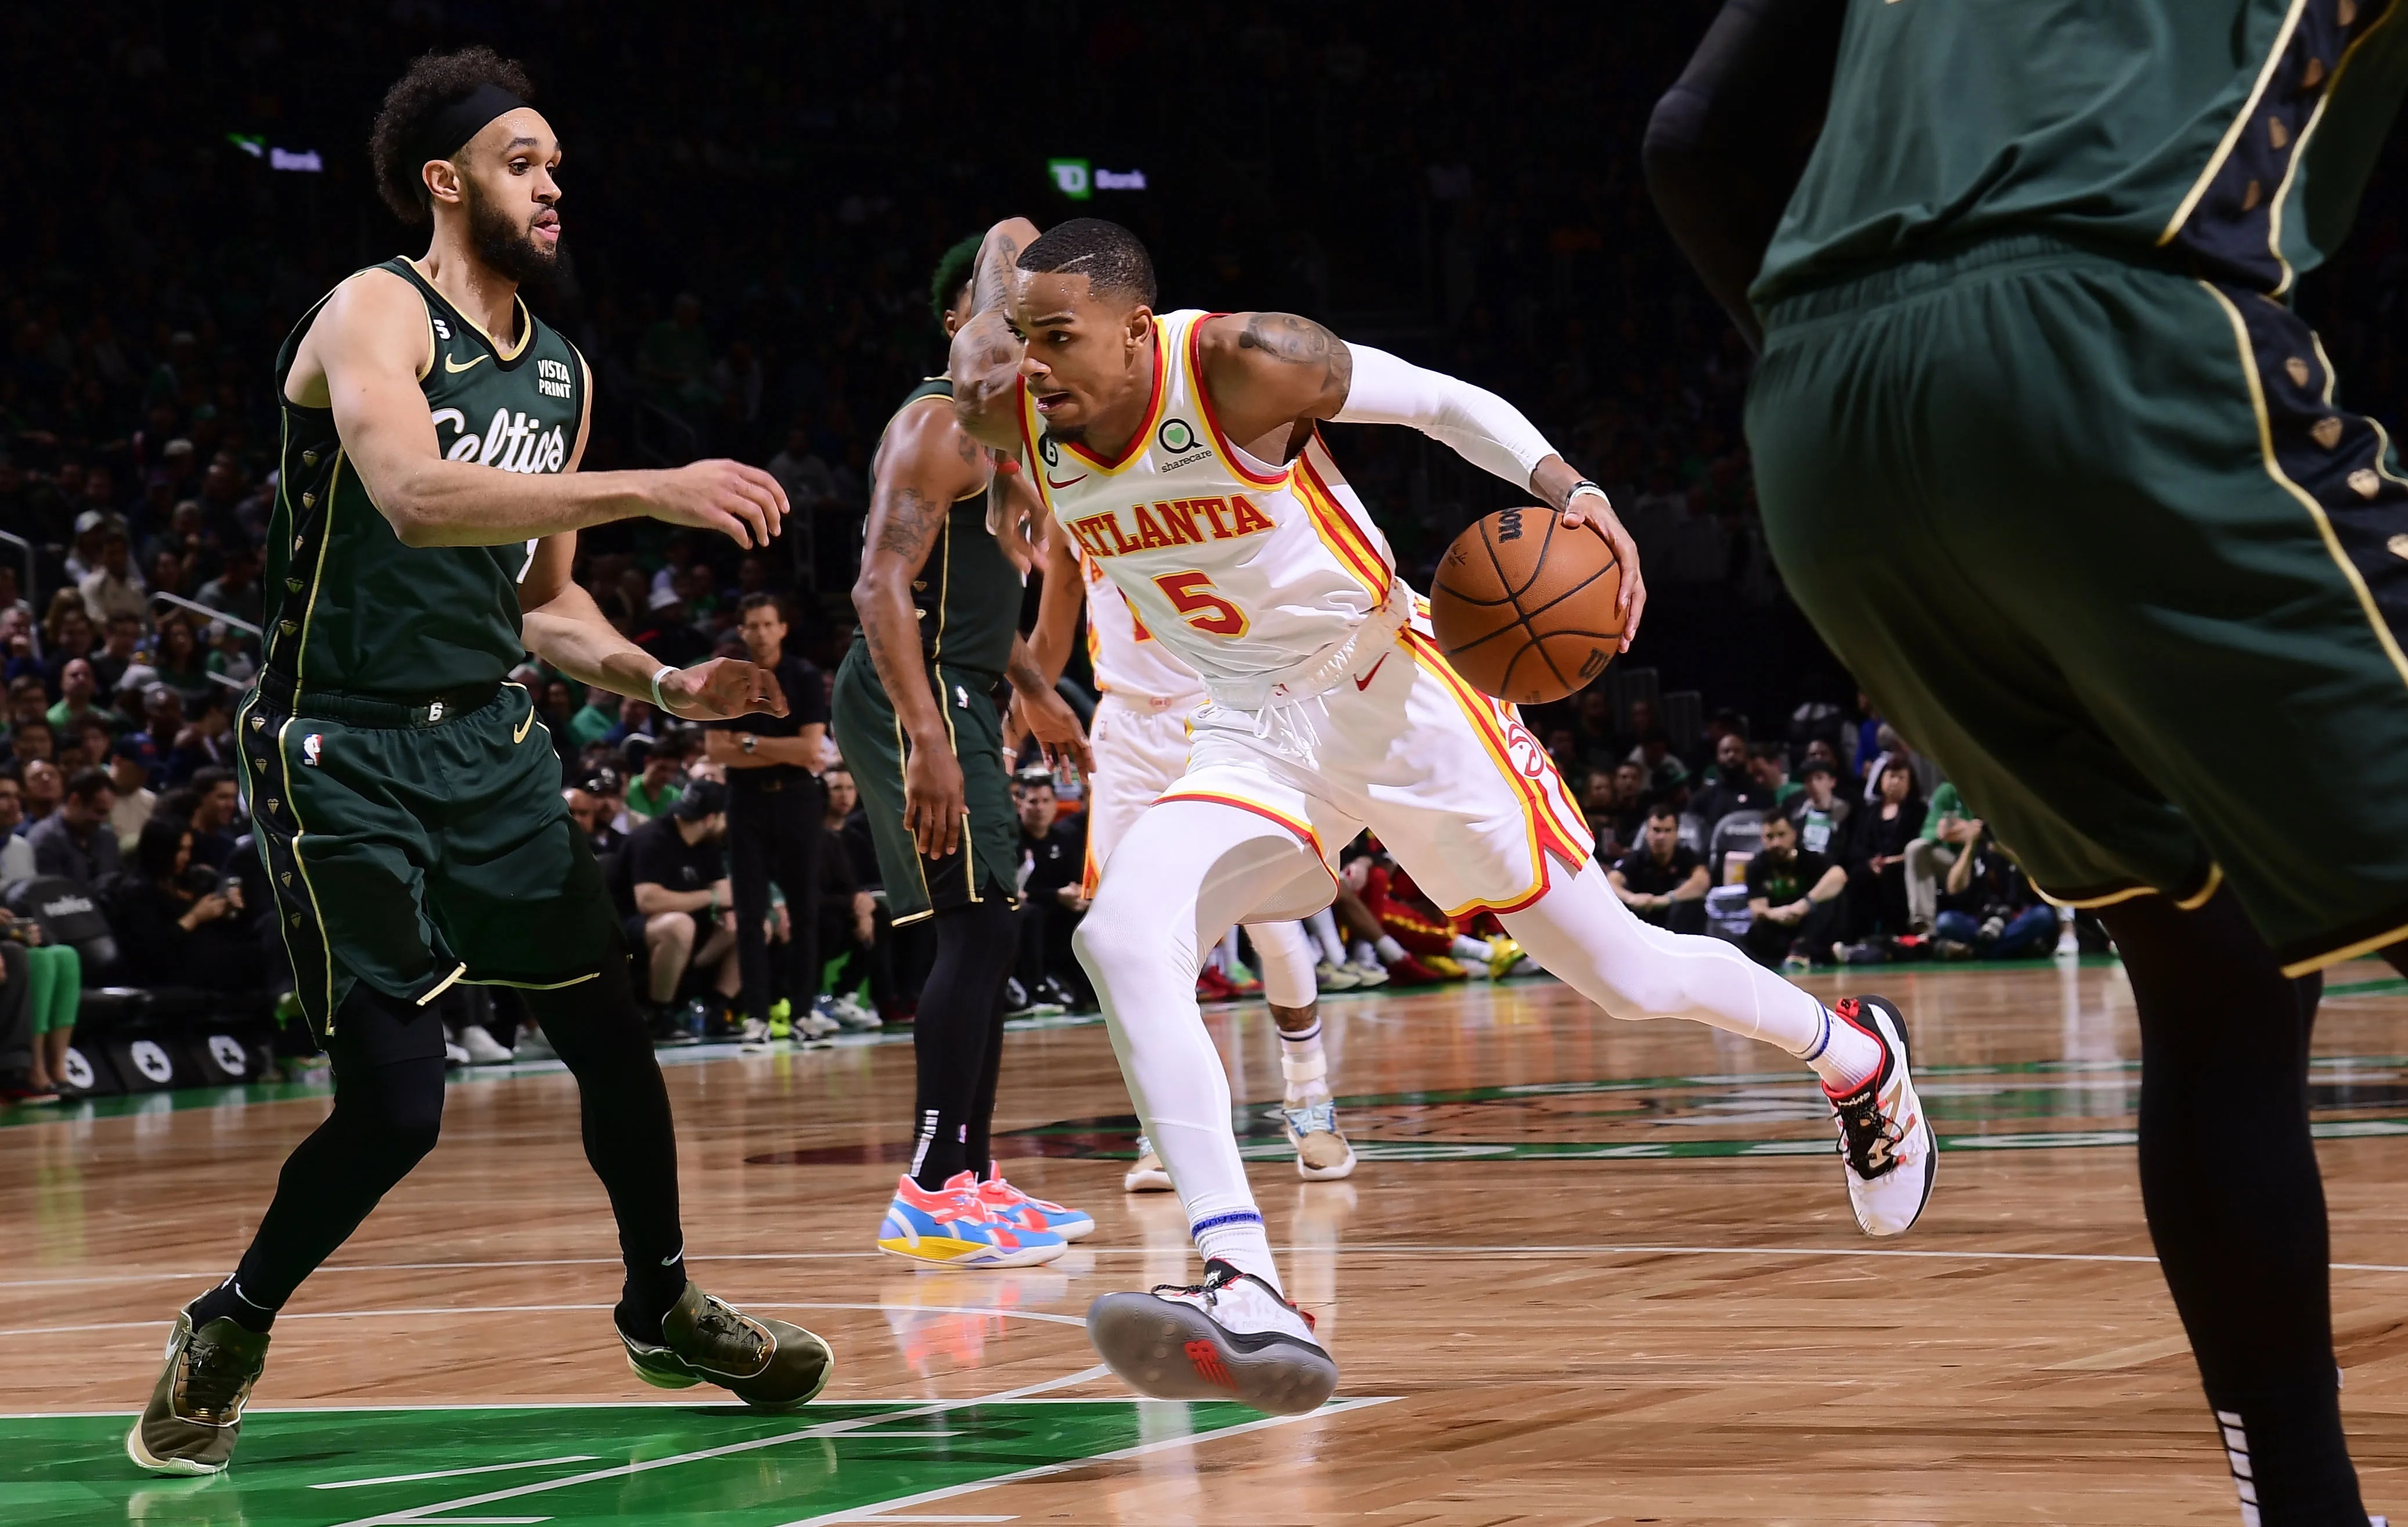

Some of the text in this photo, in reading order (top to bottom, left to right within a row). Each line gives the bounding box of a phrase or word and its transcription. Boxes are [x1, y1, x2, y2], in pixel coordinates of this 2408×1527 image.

[537, 359, 570, 383] VISTA
[539, 379, 571, 398] PRINT
[1161, 448, 1212, 474] sharecare
[1065, 494, 1277, 557] ATLANTA
[1150, 568, 1251, 639] 5
[428, 701, 444, 722] 6
